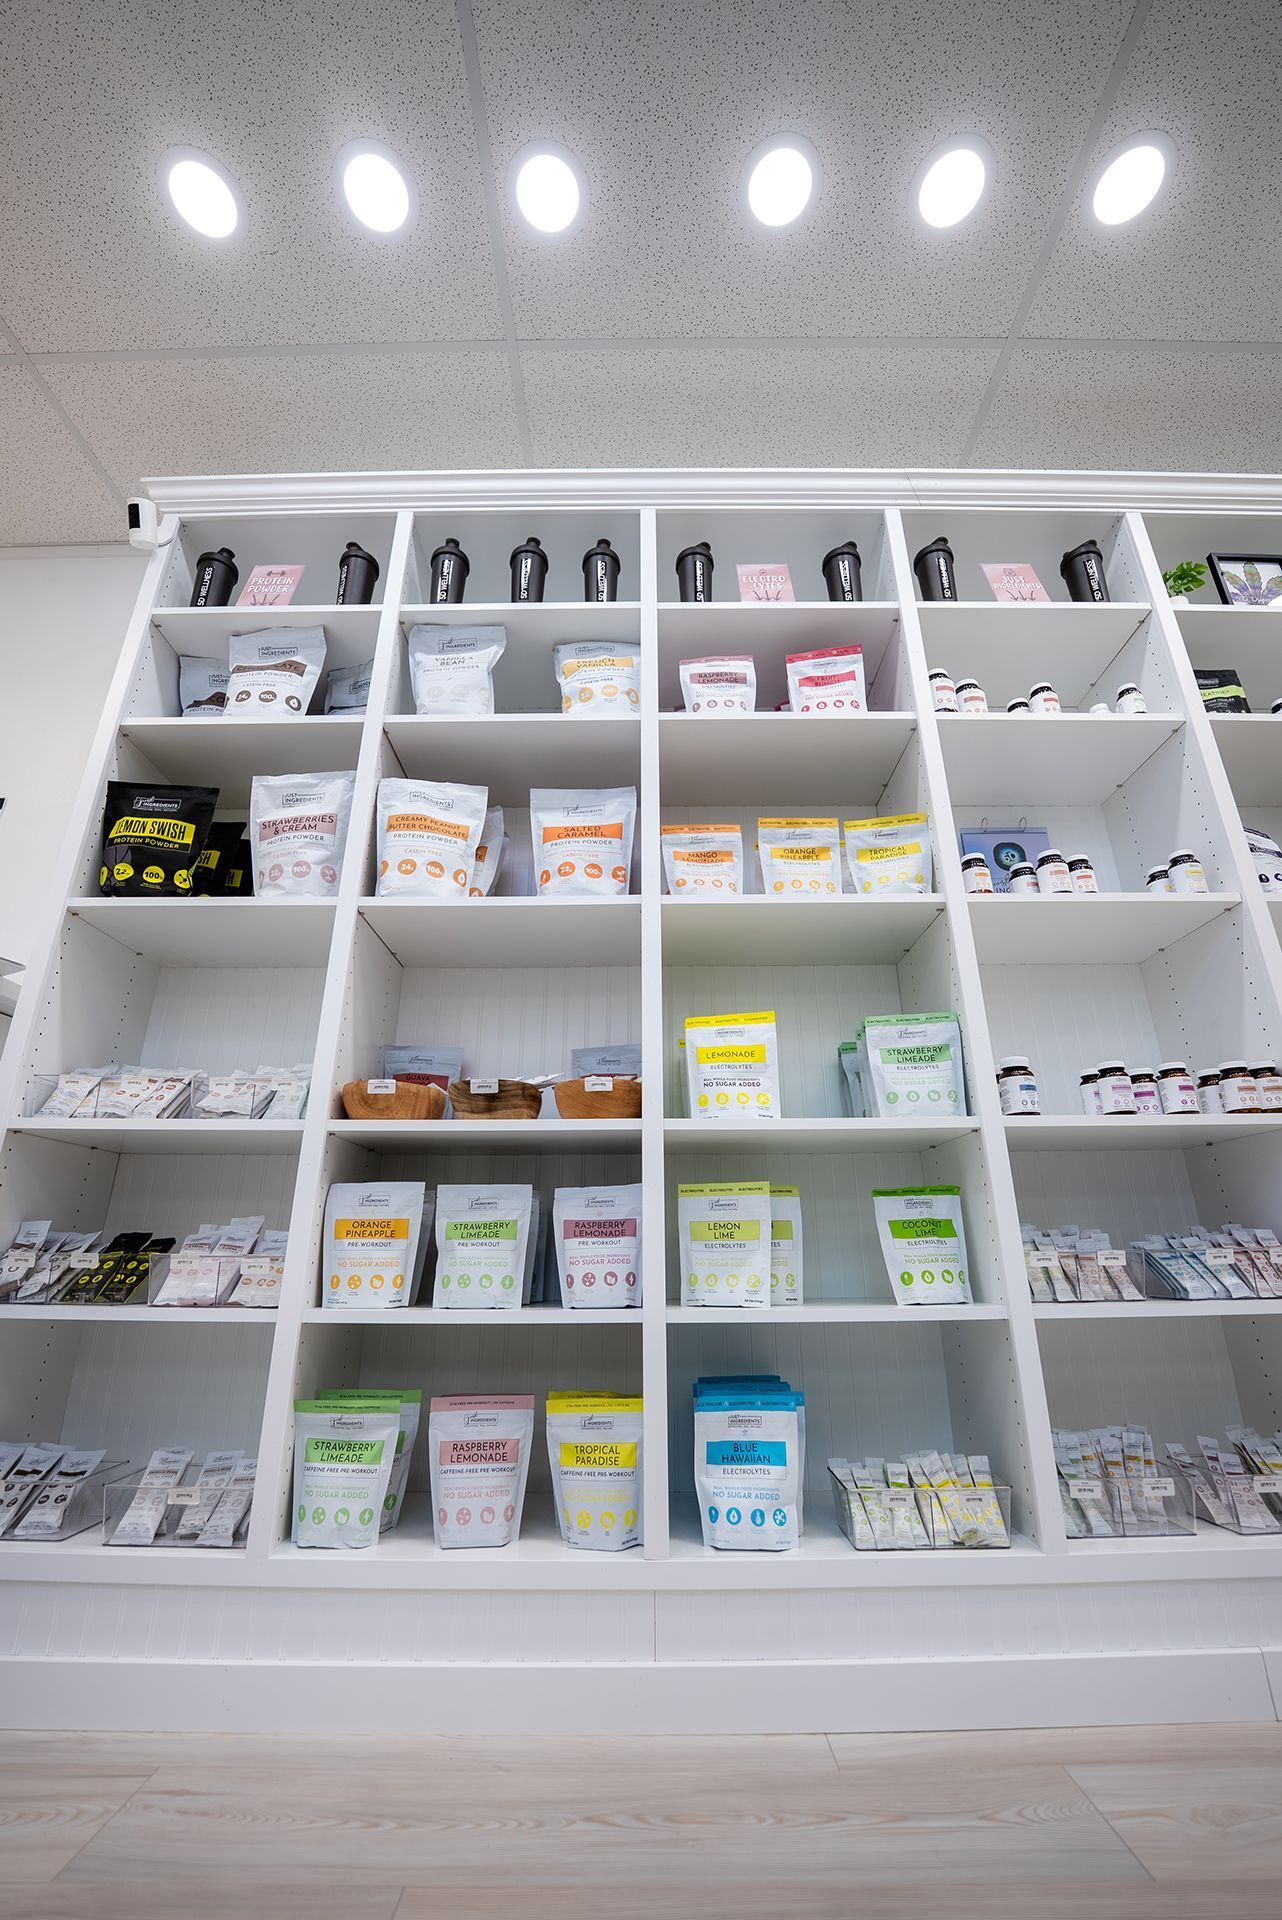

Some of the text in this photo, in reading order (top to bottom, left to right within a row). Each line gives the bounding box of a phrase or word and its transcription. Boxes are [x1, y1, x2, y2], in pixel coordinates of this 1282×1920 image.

[199, 566, 213, 593] WELLNESS
[743, 575, 787, 583] ELECTRO
[1000, 575, 1026, 584] JUST
[1086, 560, 1099, 590] WELLNESS
[250, 577, 294, 586] PROTEIN
[248, 585, 291, 593] POWDER
[697, 676, 739, 684] LEMONADE
[698, 671, 738, 679] RASPBERRY
[411, 793, 452, 807] INGREDIENTS
[261, 814, 335, 830] STRAWBERRIES
[395, 815, 461, 831] CREAMY PEANUT
[115, 818, 187, 841] LEMON SWISH
[273, 823, 318, 836] & CREAM
[389, 822, 467, 839] BUTTER CHOCOLATE
[563, 825, 602, 833] SALTED
[266, 833, 325, 846] PROTEIN POWDER
[393, 832, 459, 846] PROTEIN POWDER
[556, 830, 607, 839] CARAMEL
[113, 837, 180, 849] PROTEIN POWDER
[550, 839, 580, 847] PROTEIN
[783, 847, 817, 855] ORANGE
[869, 846, 905, 856] TROPICAL
[870, 850, 907, 861] PARADISE
[682, 856, 726, 864] LEMONADE
[706, 1050, 756, 1060] LEMONADE
[886, 1045, 944, 1057] STRAWBERRY
[896, 1054, 936, 1064] LIMEADE
[710, 1063, 753, 1071] ELECTROLYTES
[896, 1063, 940, 1071] ELECTROLYTES
[351, 1220, 392, 1230] ORANGE
[453, 1221, 511, 1231] STRAWBERRY
[574, 1221, 626, 1230] RASPBERRY
[707, 1222, 741, 1231] LEMON
[902, 1219, 942, 1230] COCONUT
[345, 1229, 397, 1239] PINEAPPLE
[460, 1231, 501, 1239] LIMEADE
[573, 1229, 627, 1238] LEMONADE
[713, 1230, 736, 1240] LIME
[915, 1228, 937, 1238] LIME
[347, 1241, 392, 1249] PRE-WORKOUT
[578, 1239, 622, 1247] PRE-WORKOUT
[704, 1242, 747, 1250] ELECTROLYTES
[907, 1239, 947, 1247] ELECTROLYTES
[374, 1260, 400, 1268] ADDED
[313, 1440, 377, 1453] STRAWBERRY
[452, 1441, 508, 1453] RASPBERRY
[574, 1445, 621, 1455] TROPICAL
[733, 1442, 758, 1453] BLUE
[320, 1453, 364, 1463] LIMEADE
[450, 1451, 508, 1464] LEMONADE
[575, 1456, 620, 1466] PARADISE
[721, 1454, 771, 1464] HAWAIIAN
[560, 1470, 635, 1478] CAFFEINE-FREE PRE-WORKOUT
[722, 1468, 771, 1476] ELECTROLYTES
[304, 1490, 369, 1500] NO SUGAR ADDED
[443, 1489, 510, 1499] NO SUGAR ADDED
[712, 1490, 780, 1501] NO SUGAR ADDED
